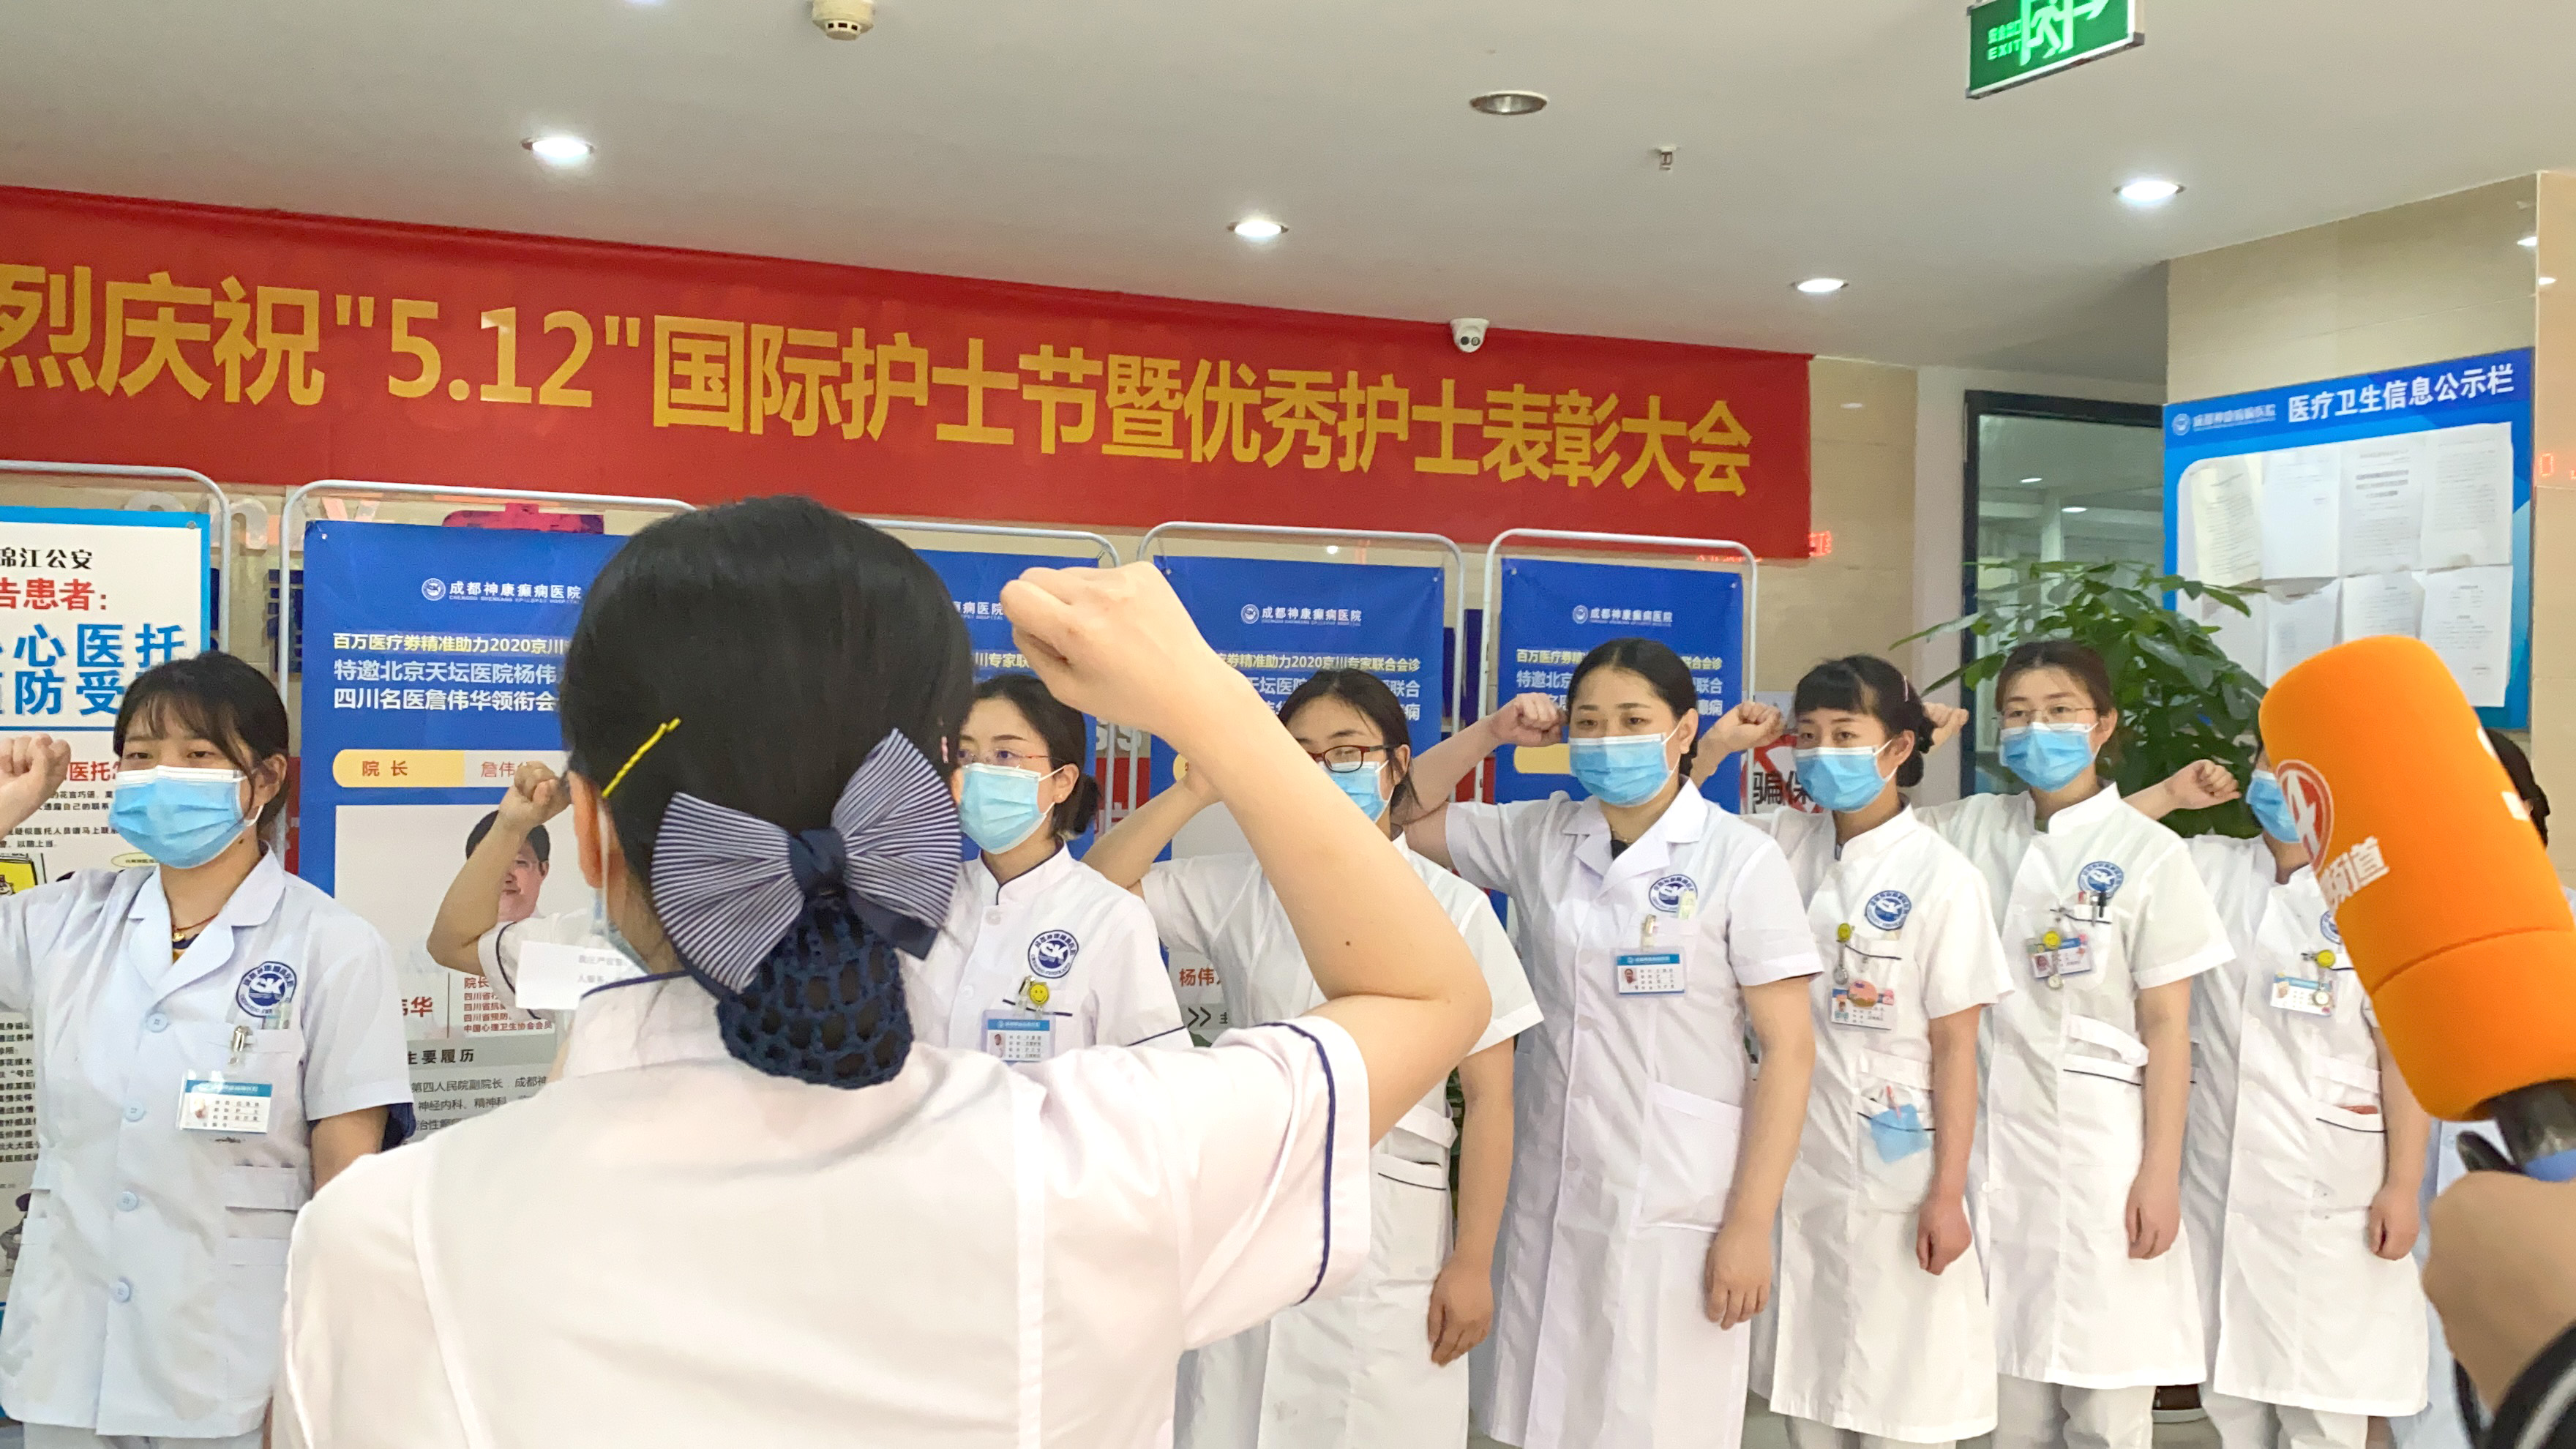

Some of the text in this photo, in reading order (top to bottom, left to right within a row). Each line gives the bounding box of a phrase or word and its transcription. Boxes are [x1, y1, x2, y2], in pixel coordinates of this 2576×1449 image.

[1987, 38, 2021, 60] EXIT
[2288, 363, 2515, 424] 医疗卫生信息公示栏
[449, 580, 582, 600] 成都神康癫痫医院
[0, 622, 187, 668] 心医托
[480, 761, 525, 779] 詹伟
[1179, 965, 1222, 987] 杨伟
